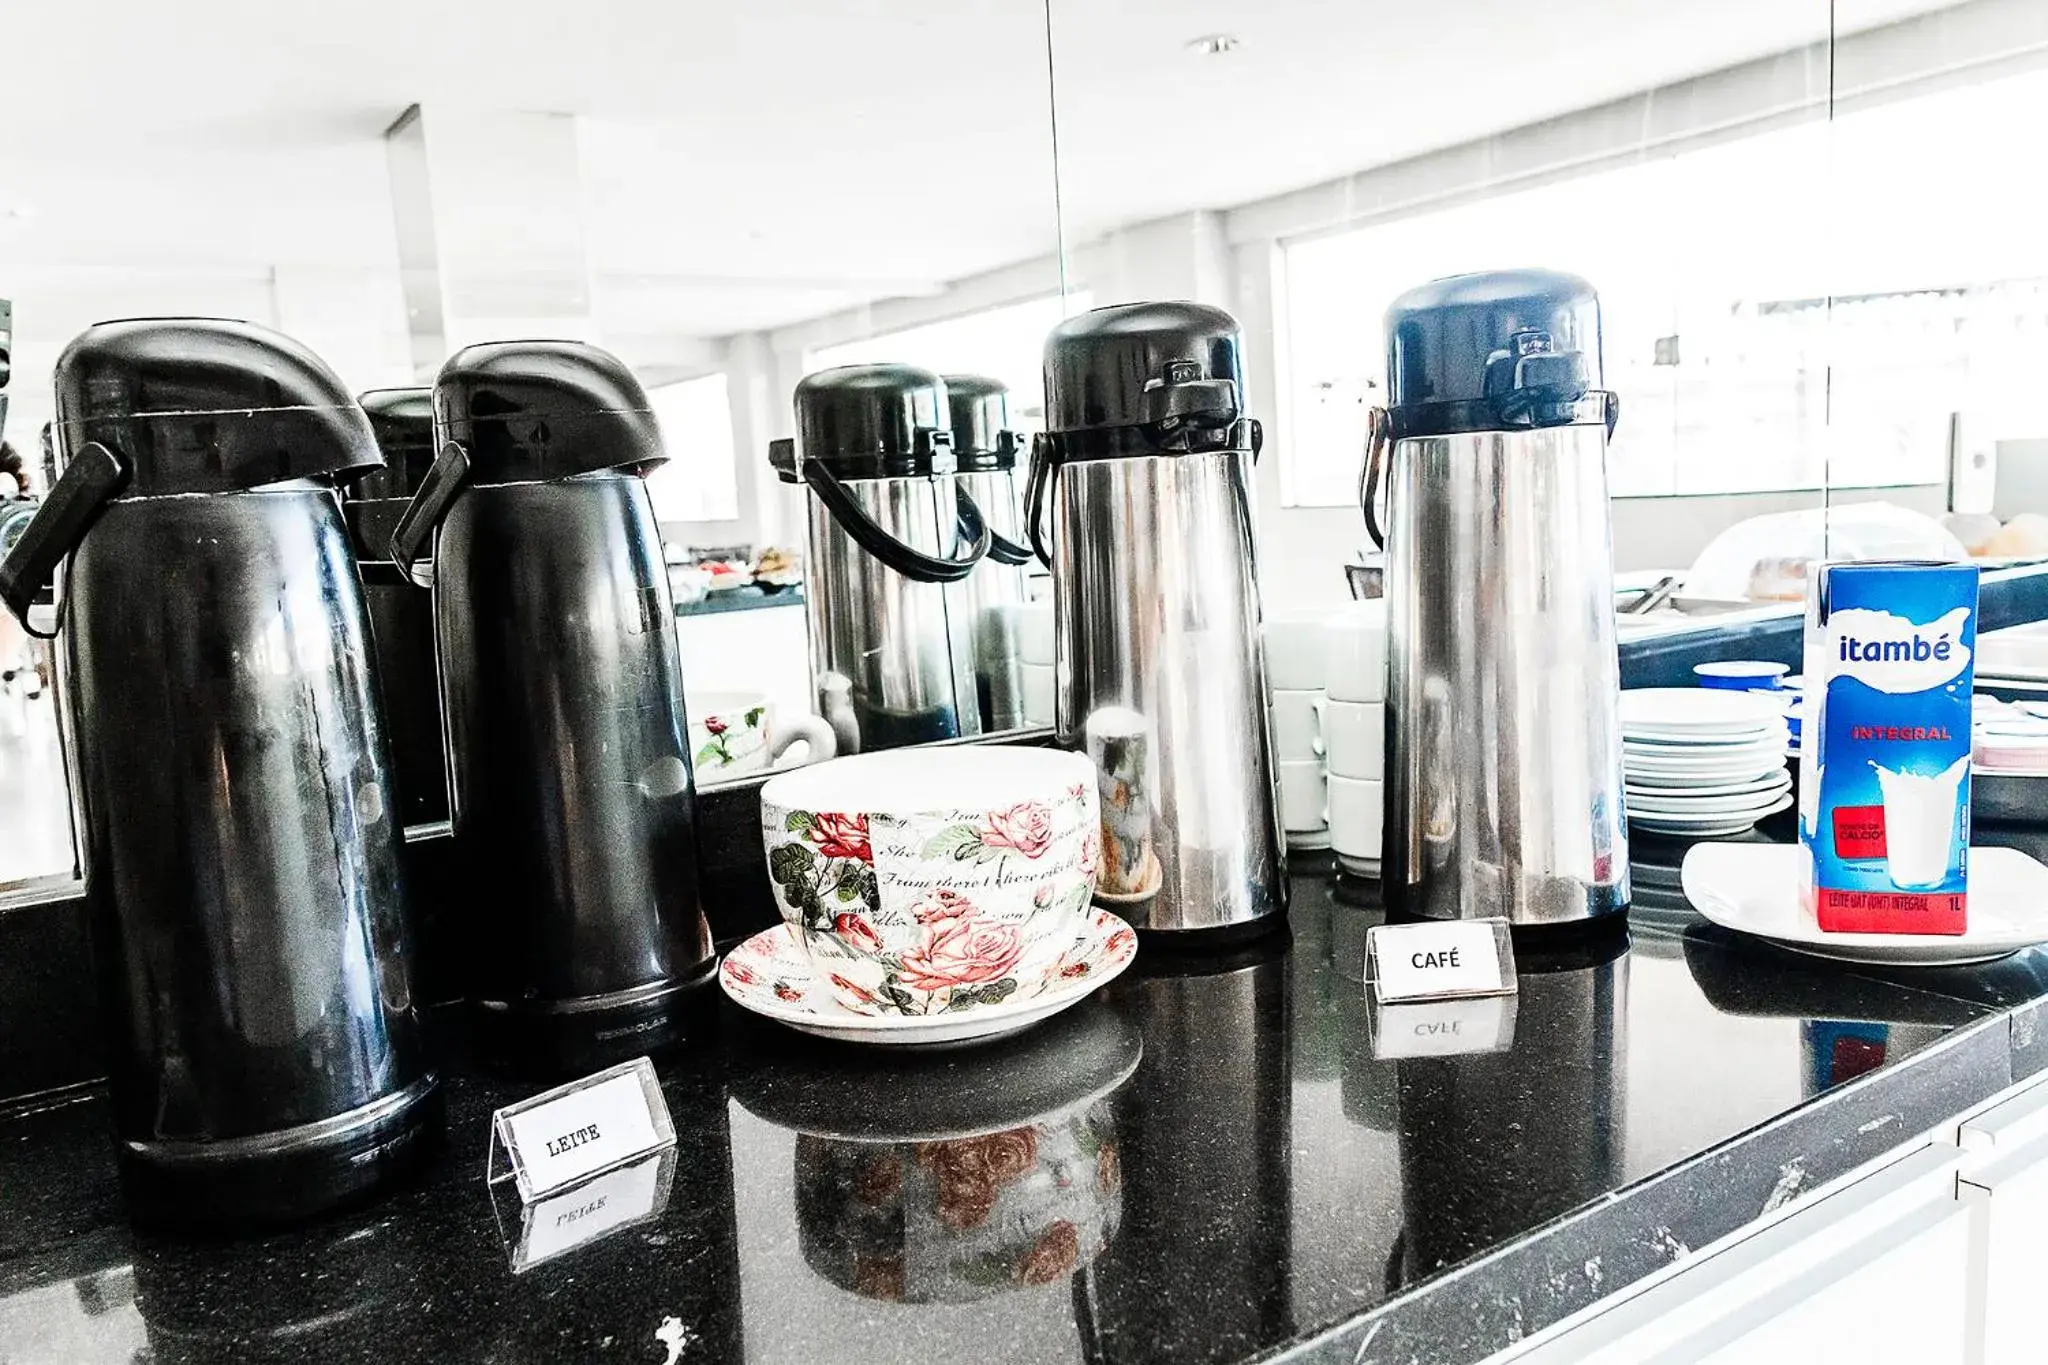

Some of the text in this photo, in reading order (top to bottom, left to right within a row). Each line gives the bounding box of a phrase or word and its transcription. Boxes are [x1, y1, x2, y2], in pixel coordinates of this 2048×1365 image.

[1839, 633, 1951, 662] itambé
[1851, 726, 1952, 742] INTEGRAL
[1891, 896, 1929, 912] INTEGRAL
[1949, 897, 1961, 911] 1L
[1411, 946, 1461, 969] CAFÉ
[545, 1123, 601, 1157] LEITE
